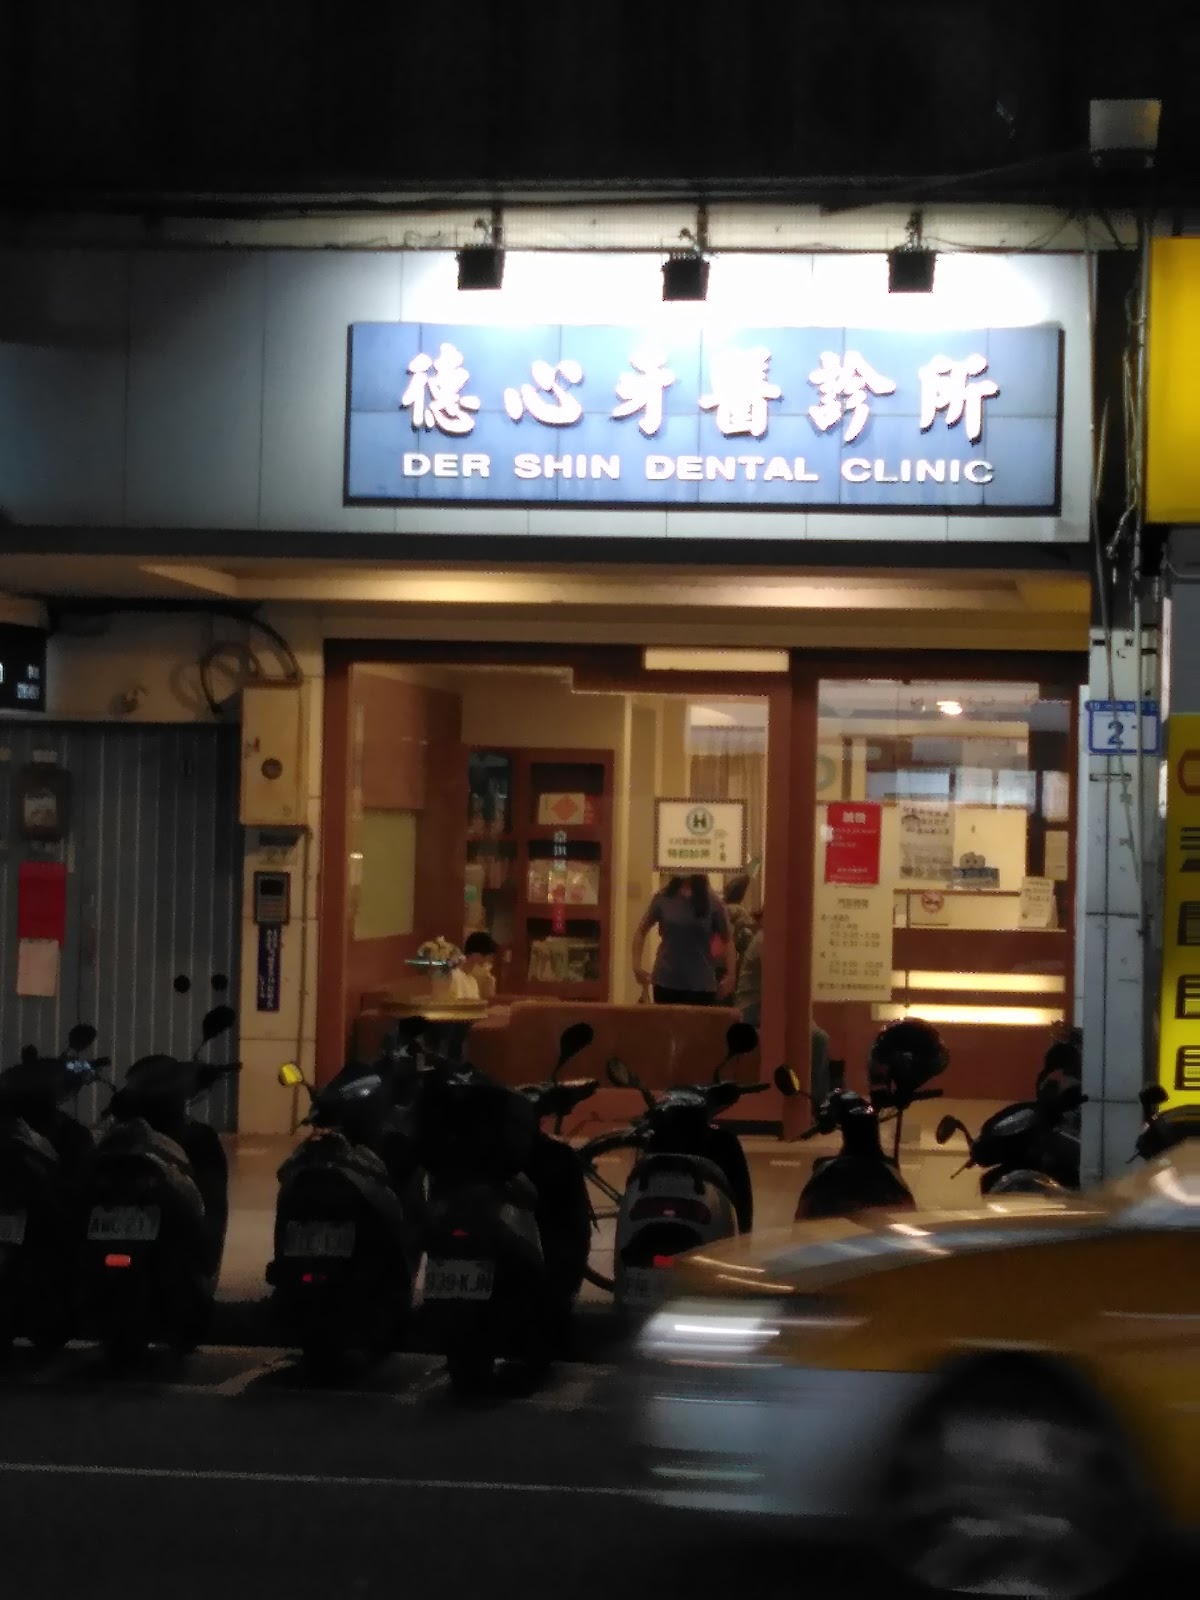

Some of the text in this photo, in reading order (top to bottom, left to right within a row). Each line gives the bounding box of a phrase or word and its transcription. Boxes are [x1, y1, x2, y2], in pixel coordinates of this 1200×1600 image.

[401, 343, 1000, 443] 德心牙醫診所
[403, 453, 994, 483] DER SHIN DENTAL CLINIC
